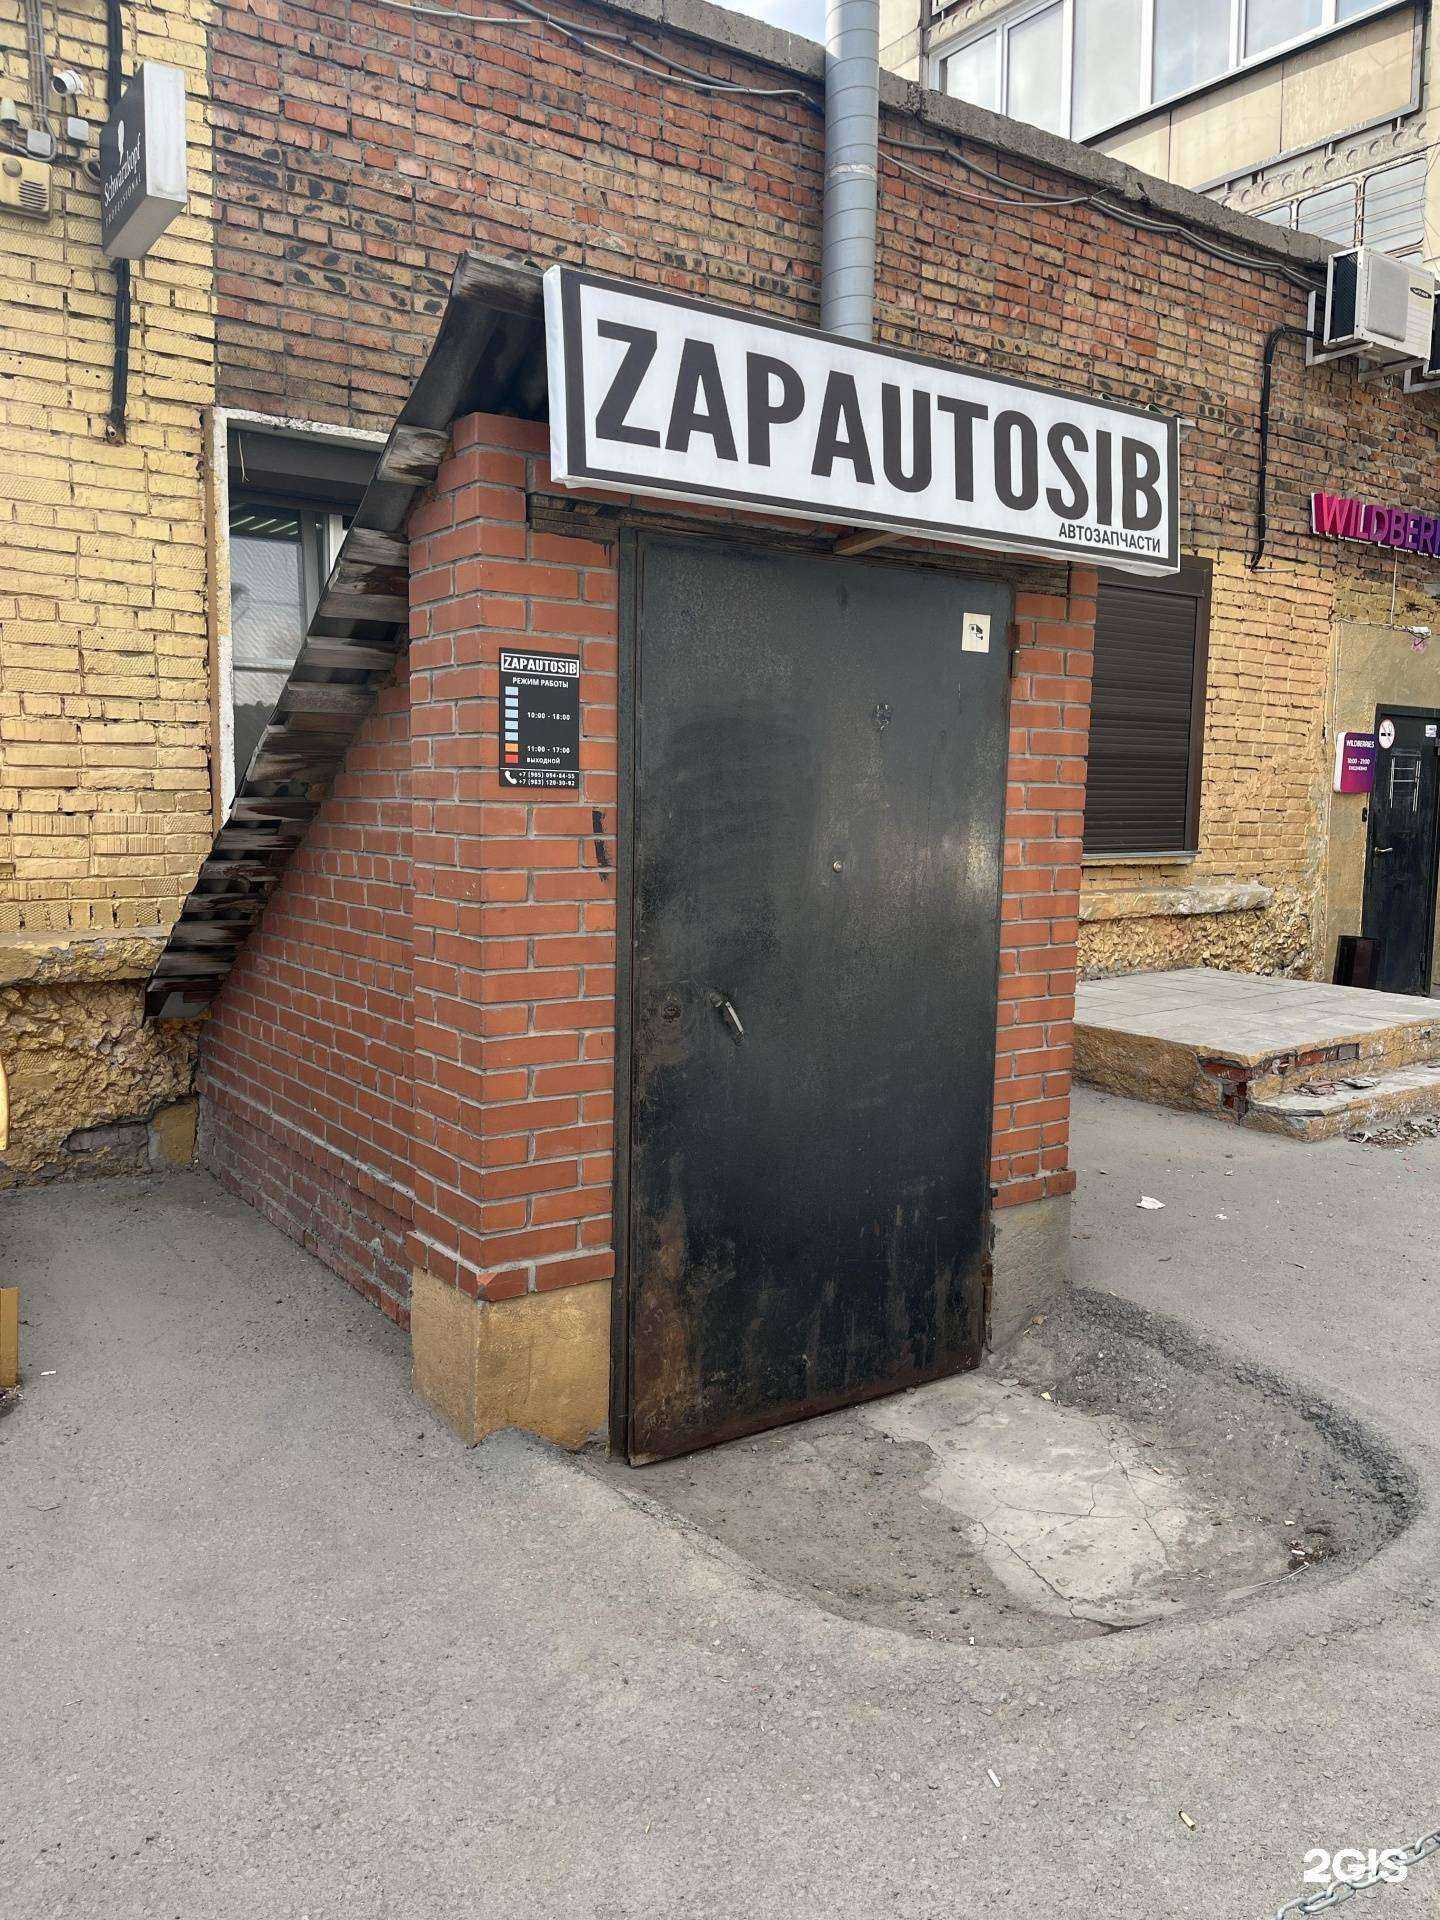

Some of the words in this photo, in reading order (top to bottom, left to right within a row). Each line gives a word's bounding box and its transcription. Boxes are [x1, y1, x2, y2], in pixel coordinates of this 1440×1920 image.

[104, 132, 140, 207] Schwarzkopf
[595, 318, 1163, 532] ZAPAUTOSIB
[1059, 522, 1161, 553] АВТОЗАПЧАСТИ
[504, 657, 577, 674] ZAPAUTOSIB
[512, 677, 540, 686] РЕЖИМ
[540, 679, 569, 688] РАБОТЫ
[552, 746, 571, 754] 17:00
